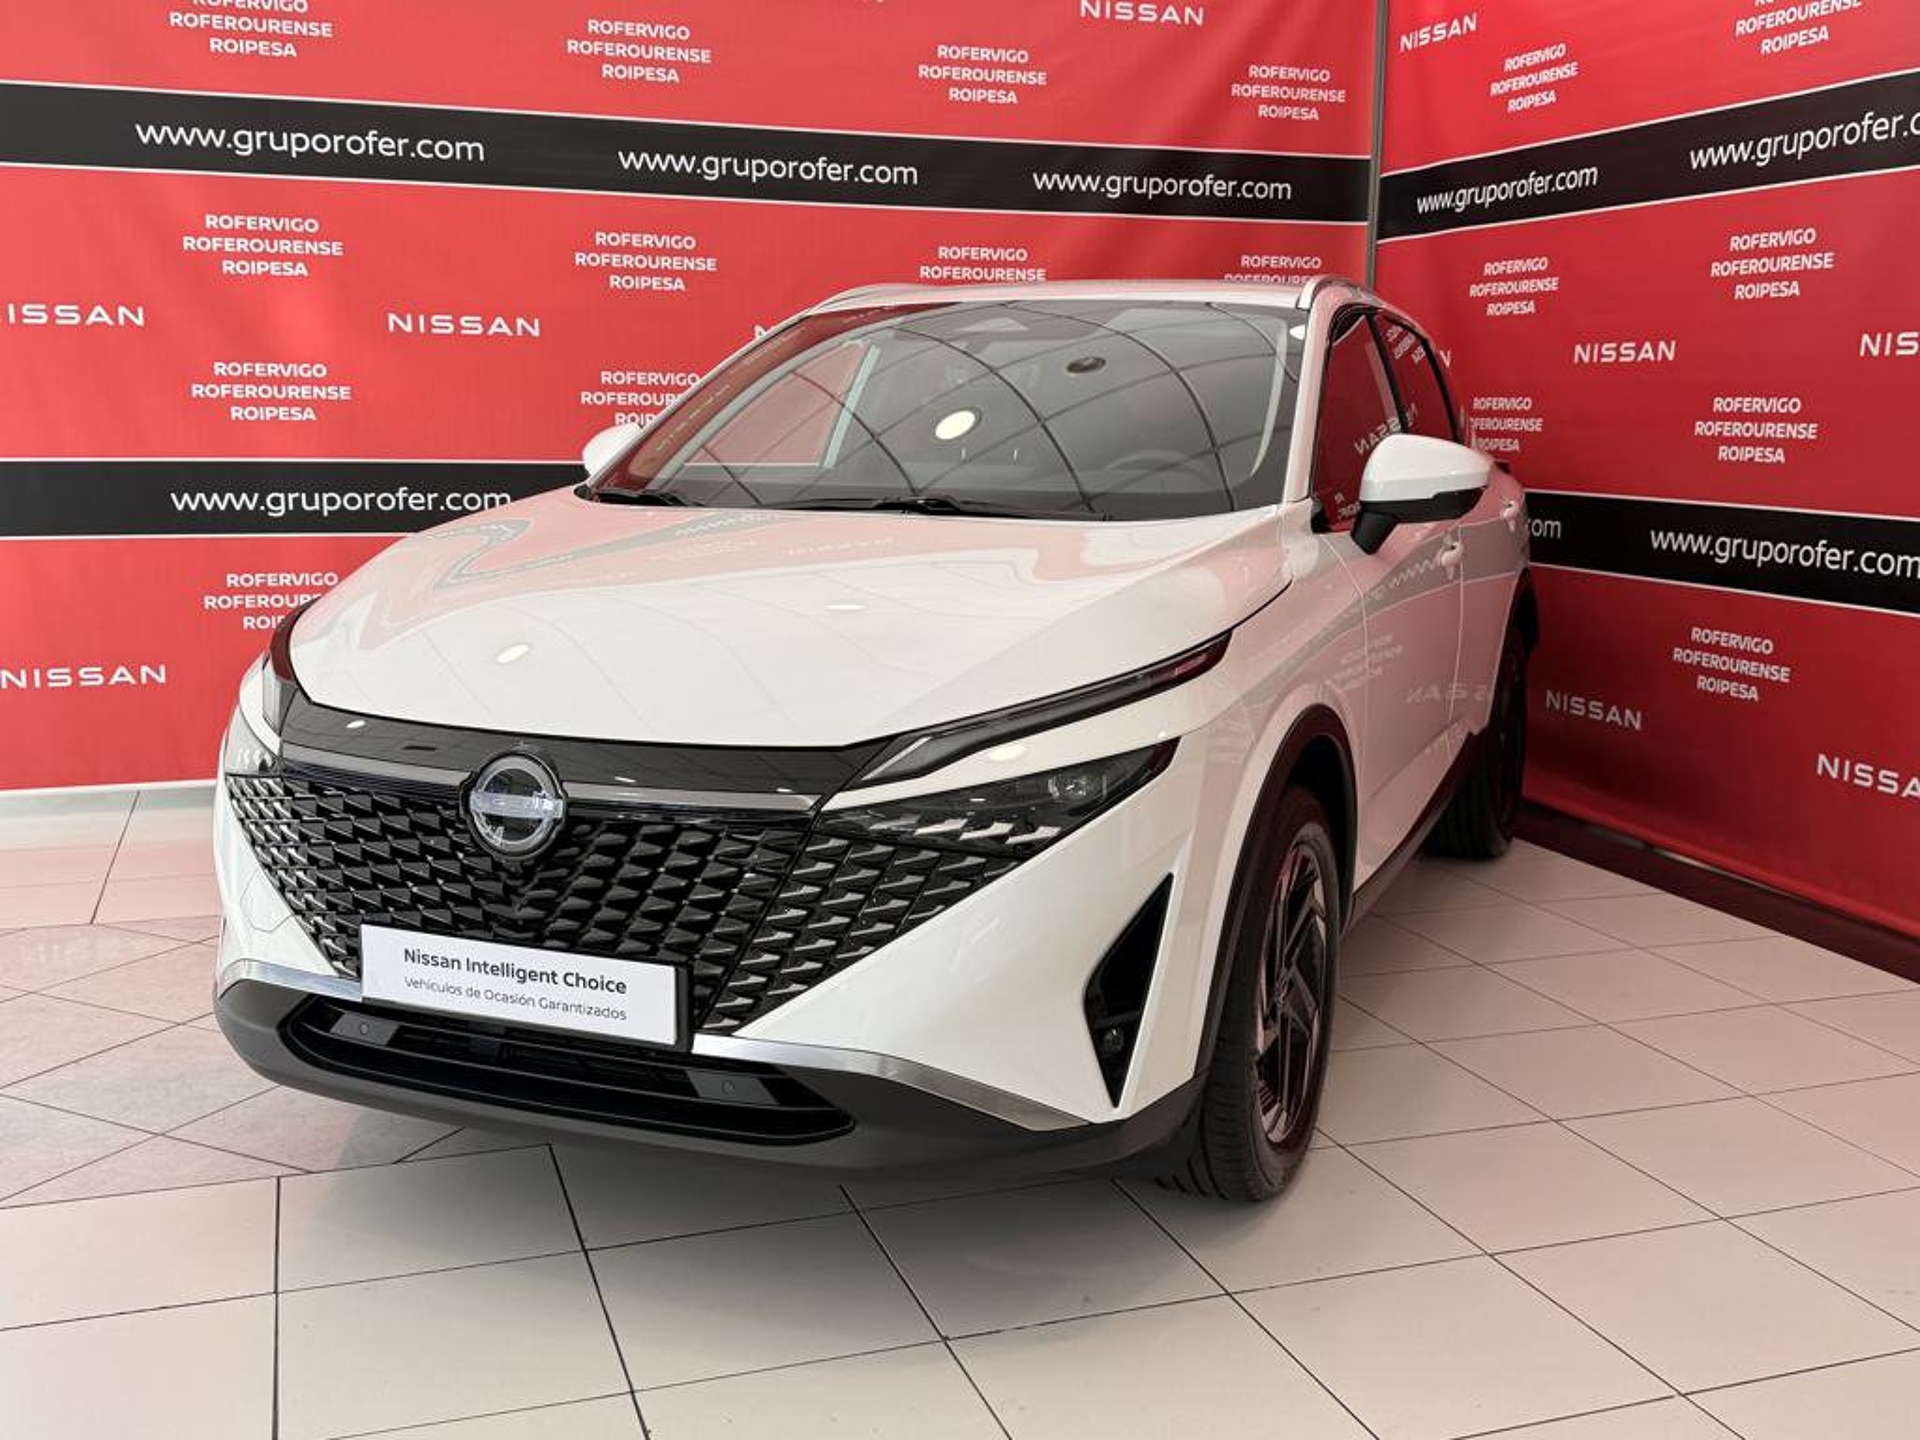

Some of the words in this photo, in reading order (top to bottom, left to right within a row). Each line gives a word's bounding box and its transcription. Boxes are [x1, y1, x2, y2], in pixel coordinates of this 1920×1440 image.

[1080, 0, 1204, 26] NISSAN
[169, 11, 332, 38] ROFEROURENSE
[587, 19, 691, 41] ROFERVIGO
[1400, 13, 1477, 52] NISSAN
[209, 37, 297, 57] ROIPESA
[1760, 25, 1829, 55] ROIPESA
[567, 39, 712, 63] ROFEROURENSE
[937, 44, 1029, 64] ROFERVIGO
[1504, 43, 1567, 72] ROFERVIGO
[601, 63, 680, 83] ROIPESA
[918, 64, 1047, 85] ROFEROURENSE
[1248, 64, 1331, 83] ROFERVIGO
[1490, 61, 1578, 96] ROFEROURENSE
[948, 87, 1018, 104] ROIPESA
[1231, 83, 1346, 103] ROFEROURENSE
[1507, 89, 1557, 112] ROIPESA
[1258, 104, 1319, 121] ROIPESA
[135, 123, 485, 161] www.gruporofer.com
[1690, 111, 1920, 170] www.gruporofer.c
[618, 151, 918, 185] www.gruporofer.com
[1032, 172, 1292, 200] www.gruporofer.com
[1416, 166, 1598, 214] www.gruporofer.com
[205, 214, 320, 233] ROFERVIGO
[183, 235, 343, 256] ROFEROURENSE
[595, 231, 696, 250] ROFERVIGO
[1729, 227, 1817, 252] ROFERVIGO
[574, 252, 717, 271] ROFEROURENSE
[938, 246, 1028, 262] ROFERVIGO
[1240, 254, 1322, 269] ROFERVIGO
[1710, 251, 1835, 277] ROFEROURENSE
[222, 260, 309, 277] ROIPESA
[919, 265, 1046, 283] ROFEROURENSE
[1483, 256, 1548, 276] ROFERVIGO
[609, 274, 685, 291] ROIPESA
[1469, 276, 1559, 297] ROFEROURENSE
[1734, 280, 1801, 300] ROIPESA
[7, 303, 145, 326] ISSAN
[1486, 299, 1536, 316] ROIPESA
[388, 312, 540, 337] NISSAN
[1574, 340, 1676, 363] NISSAN
[1859, 331, 1919, 357] NIS
[213, 361, 327, 378] ROFERVIGO
[600, 371, 700, 386] ROFERVIGO
[191, 383, 351, 400] ROFEROURENSE
[580, 391, 684, 407] ROFEROUR
[230, 406, 316, 421] ROIPESA
[1473, 396, 1533, 411] ROFERVIGO
[1713, 396, 1802, 414] ROFERVIGO
[1469, 417, 1544, 432] FEROURENSE
[1694, 420, 1819, 440] ROFEROURENSE
[1718, 445, 1786, 464] ROIPESA
[170, 486, 512, 516] www.gruporofer.com
[1650, 530, 1920, 580] www.gruporofer.com
[226, 572, 339, 587] ROFERVIGO
[203, 592, 322, 610] ROFEROUR
[1691, 627, 1774, 655] ROFERVIGO
[1673, 647, 1791, 683] ROFEROURENSE
[0, 664, 166, 689] NISSAN
[1696, 674, 1759, 702] ROIPESA
[1546, 690, 1642, 731] NISSAN
[1817, 753, 1920, 798] NISSA
[404, 948, 461, 971] Nissan
[466, 957, 558, 984] Intelligent
[563, 971, 628, 994] Choice
[464, 986, 481, 999] de
[538, 996, 628, 1021] Garantizados
